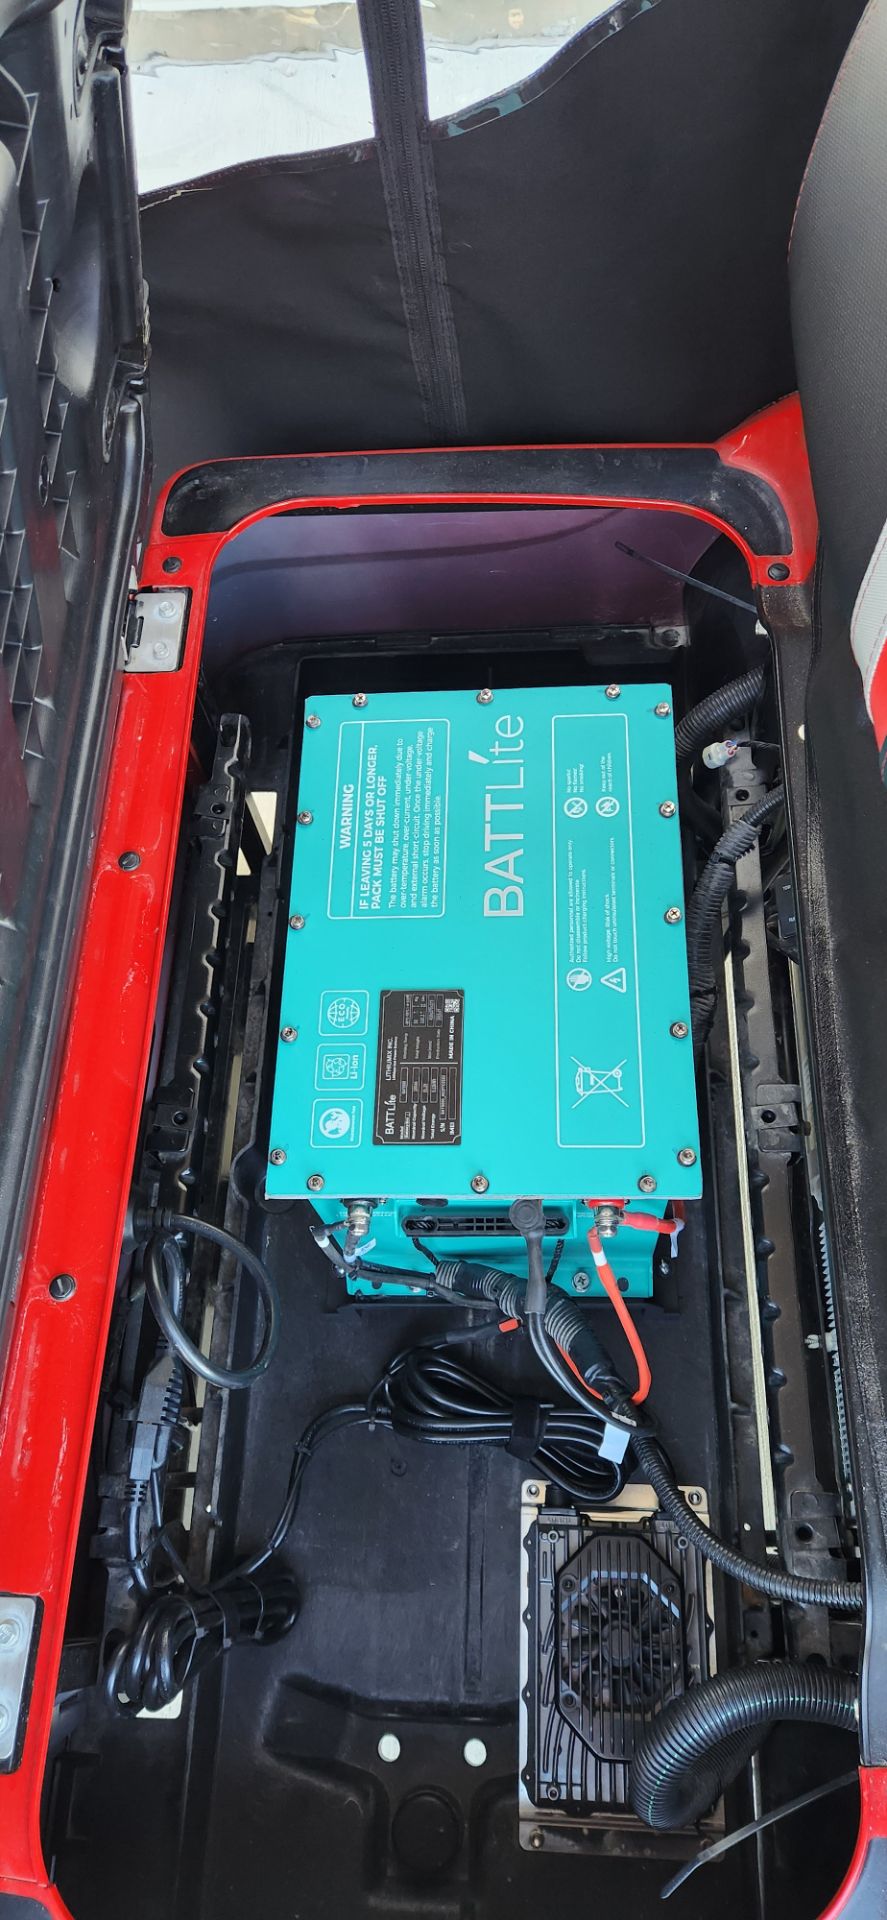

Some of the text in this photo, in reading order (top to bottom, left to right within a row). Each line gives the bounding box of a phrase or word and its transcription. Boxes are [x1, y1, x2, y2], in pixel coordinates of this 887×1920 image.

[397, 738, 403, 746] to
[426, 728, 434, 751] charge
[394, 763, 403, 806] immediately
[424, 768, 433, 812] immediately
[366, 792, 375, 807] OR
[339, 784, 354, 849] WARNING
[363, 810, 374, 837] DAYS
[423, 814, 432, 838] driving
[435, 826, 441, 834] as
[371, 776, 386, 909] PACK MUST BE SHUT OFF
[422, 840, 430, 856] stop
[392, 848, 400, 864] may
[434, 856, 440, 864] as
[360, 850, 371, 896] LEAVING
[390, 866, 399, 893] battery
[432, 866, 440, 893] battery
[359, 900, 368, 909] IF
[420, 886, 428, 907] alarm
[338, 1004, 346, 1022] ECO
